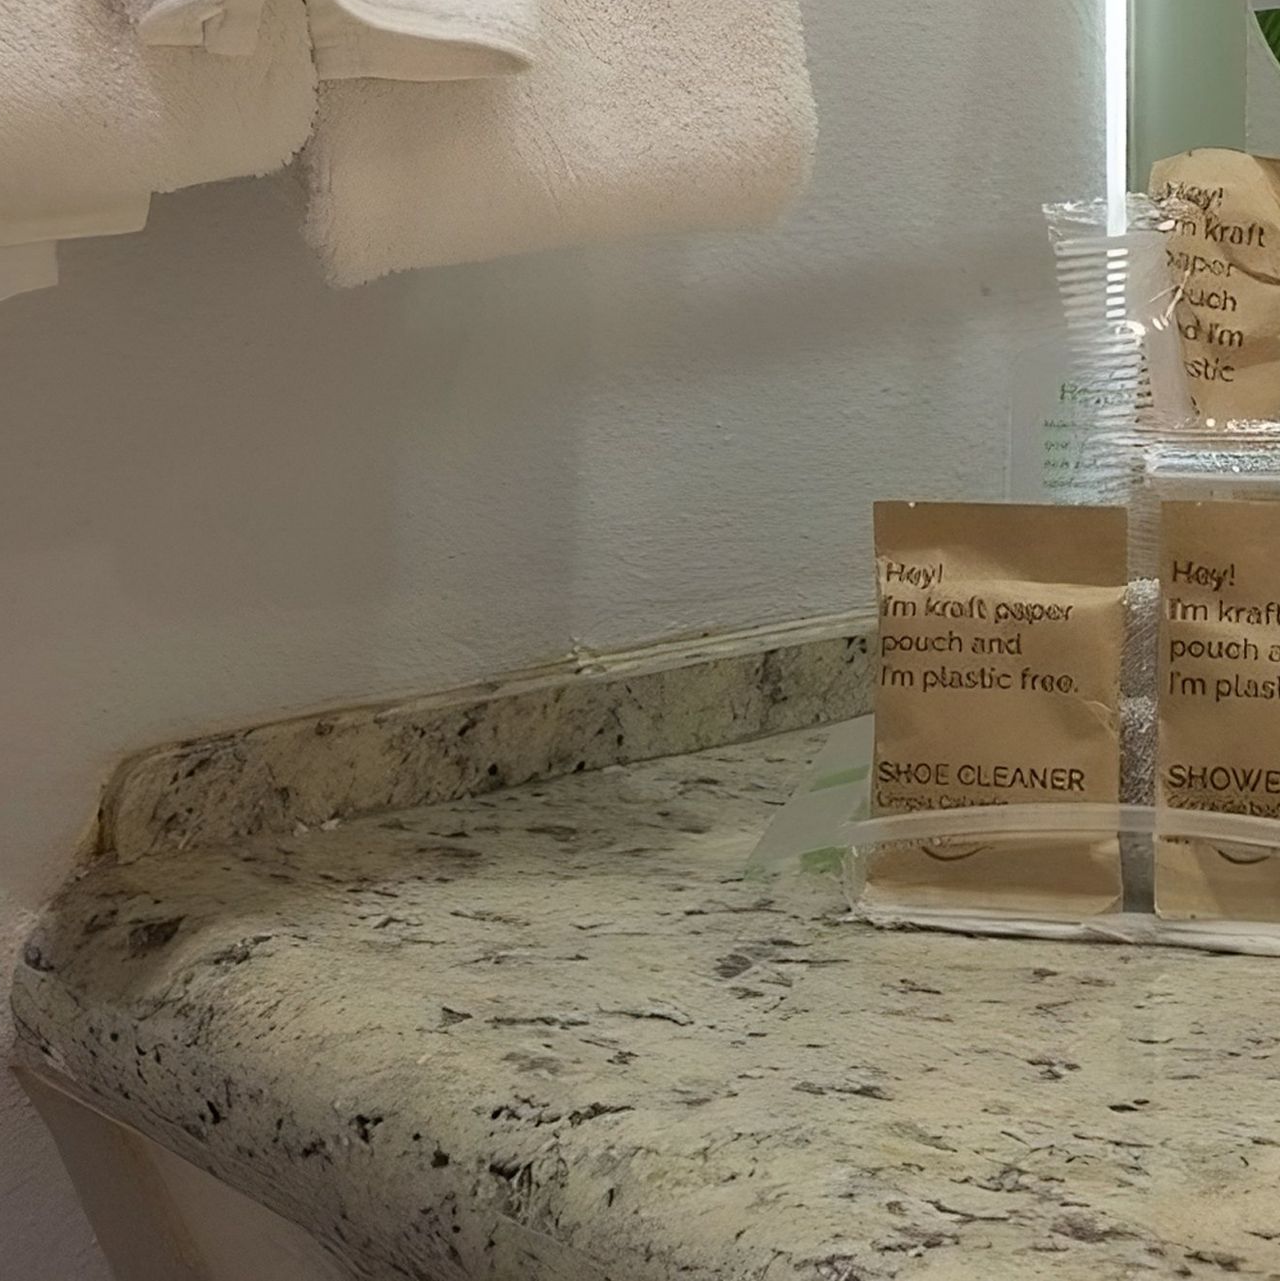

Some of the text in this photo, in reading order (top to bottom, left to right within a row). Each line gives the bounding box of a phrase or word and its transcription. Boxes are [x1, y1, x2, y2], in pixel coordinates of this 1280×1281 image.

[1205, 218, 1266, 248] kraft
[886, 563, 944, 590] Hey!
[1172, 560, 1236, 592] Hey!
[924, 596, 989, 621] kraft
[993, 601, 1074, 625] paper
[1169, 598, 1209, 623] I'm
[881, 631, 1023, 658] pouch and
[1170, 638, 1259, 663] pouch
[880, 665, 1079, 694] I'm plastic free.
[1169, 671, 1207, 697] I'm
[877, 761, 1085, 792] SHOE CLEANER
